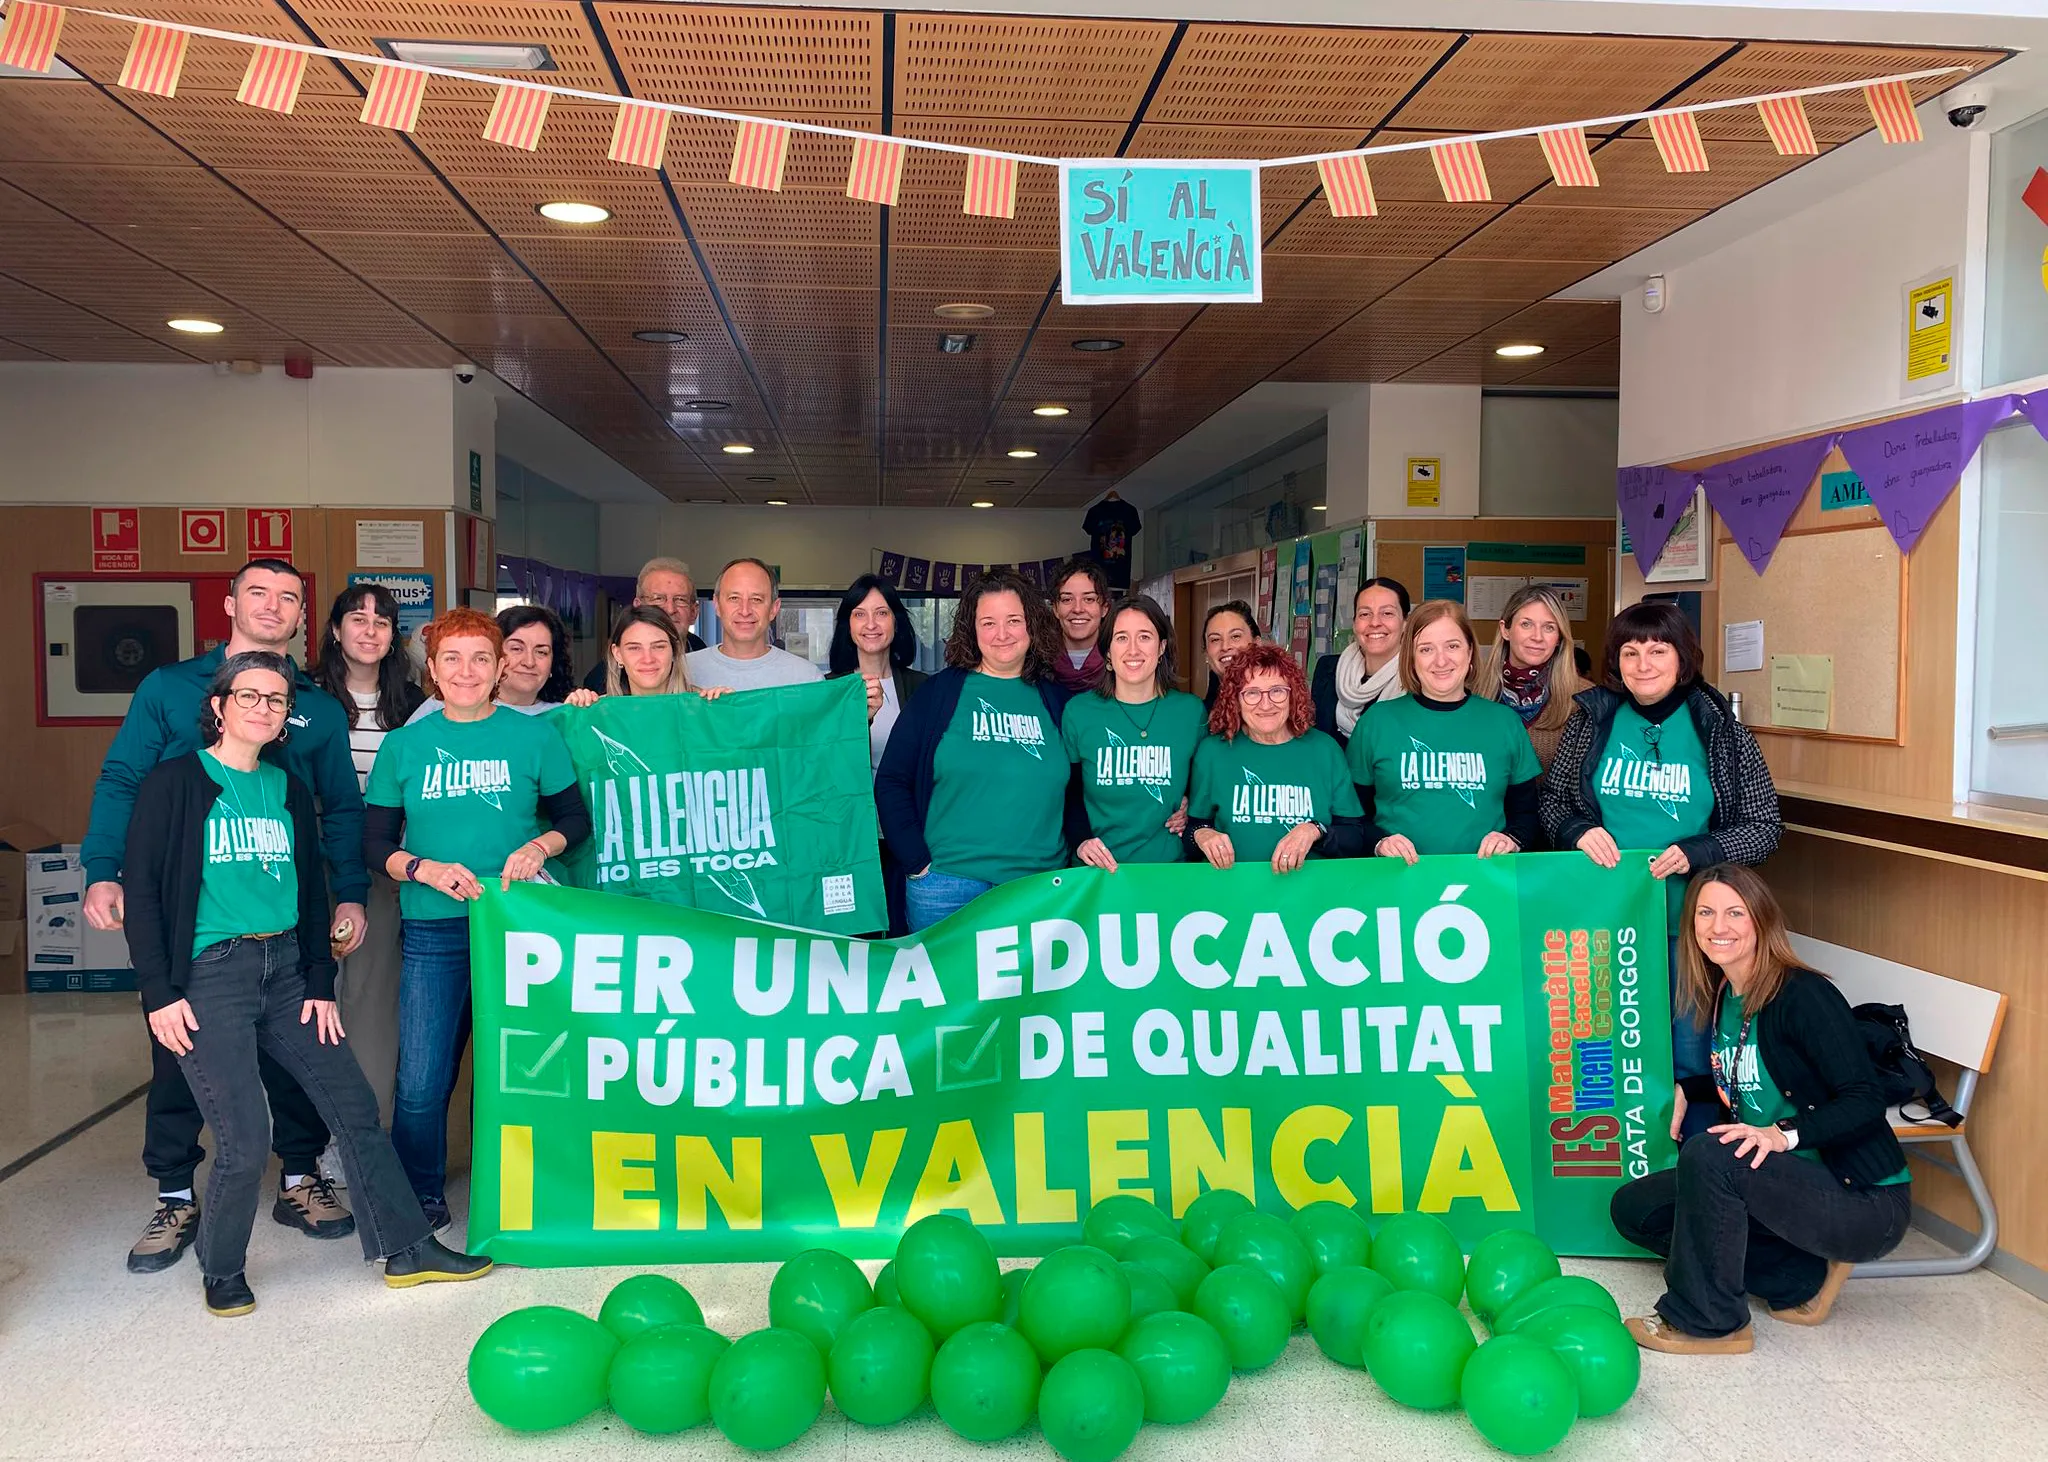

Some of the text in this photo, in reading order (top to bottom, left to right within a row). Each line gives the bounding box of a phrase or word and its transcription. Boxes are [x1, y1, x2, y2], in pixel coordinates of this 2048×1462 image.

[1083, 169, 1217, 225] SÍ AL
[1830, 480, 1871, 504] AMP
[98, 561, 137, 569] INCENDIO
[972, 711, 1045, 741] LA LLENGUA
[1013, 737, 1046, 746] TOCA
[422, 759, 511, 793] LA LLENGUA
[1097, 745, 1172, 779] LA LLENGUA
[1401, 751, 1487, 784] LA LLENGUA
[1601, 757, 1691, 796] LA LLENGUA
[421, 785, 512, 801] NO ES TOCA
[1096, 778, 1171, 786] NO ES TOCA
[1401, 782, 1485, 791] NO ES TOCA
[1600, 787, 1690, 804] NO ES TOCA
[629, 767, 777, 861] LLENGUA
[1232, 784, 1314, 818] LA LLENGUA
[209, 817, 291, 855] LA LLENGUA
[1232, 815, 1251, 823] NO
[1254, 816, 1273, 824] ES
[209, 853, 291, 864] NO ES TOCA
[639, 859, 681, 880] ES
[689, 851, 779, 874] TOCA
[505, 884, 1491, 1017] PER UNA EDUCACIÓ
[1542, 929, 1574, 1114] Matemàtic
[1569, 929, 1615, 1112] Vicent Caselles Costa
[587, 1004, 1502, 1108] PÚBLICA DE QUALITAT
[1617, 926, 1650, 1180] GATA DE GORGOS
[500, 1074, 1521, 1231] I EN VALENCIÀ
[1549, 1114, 1624, 1179] IES
